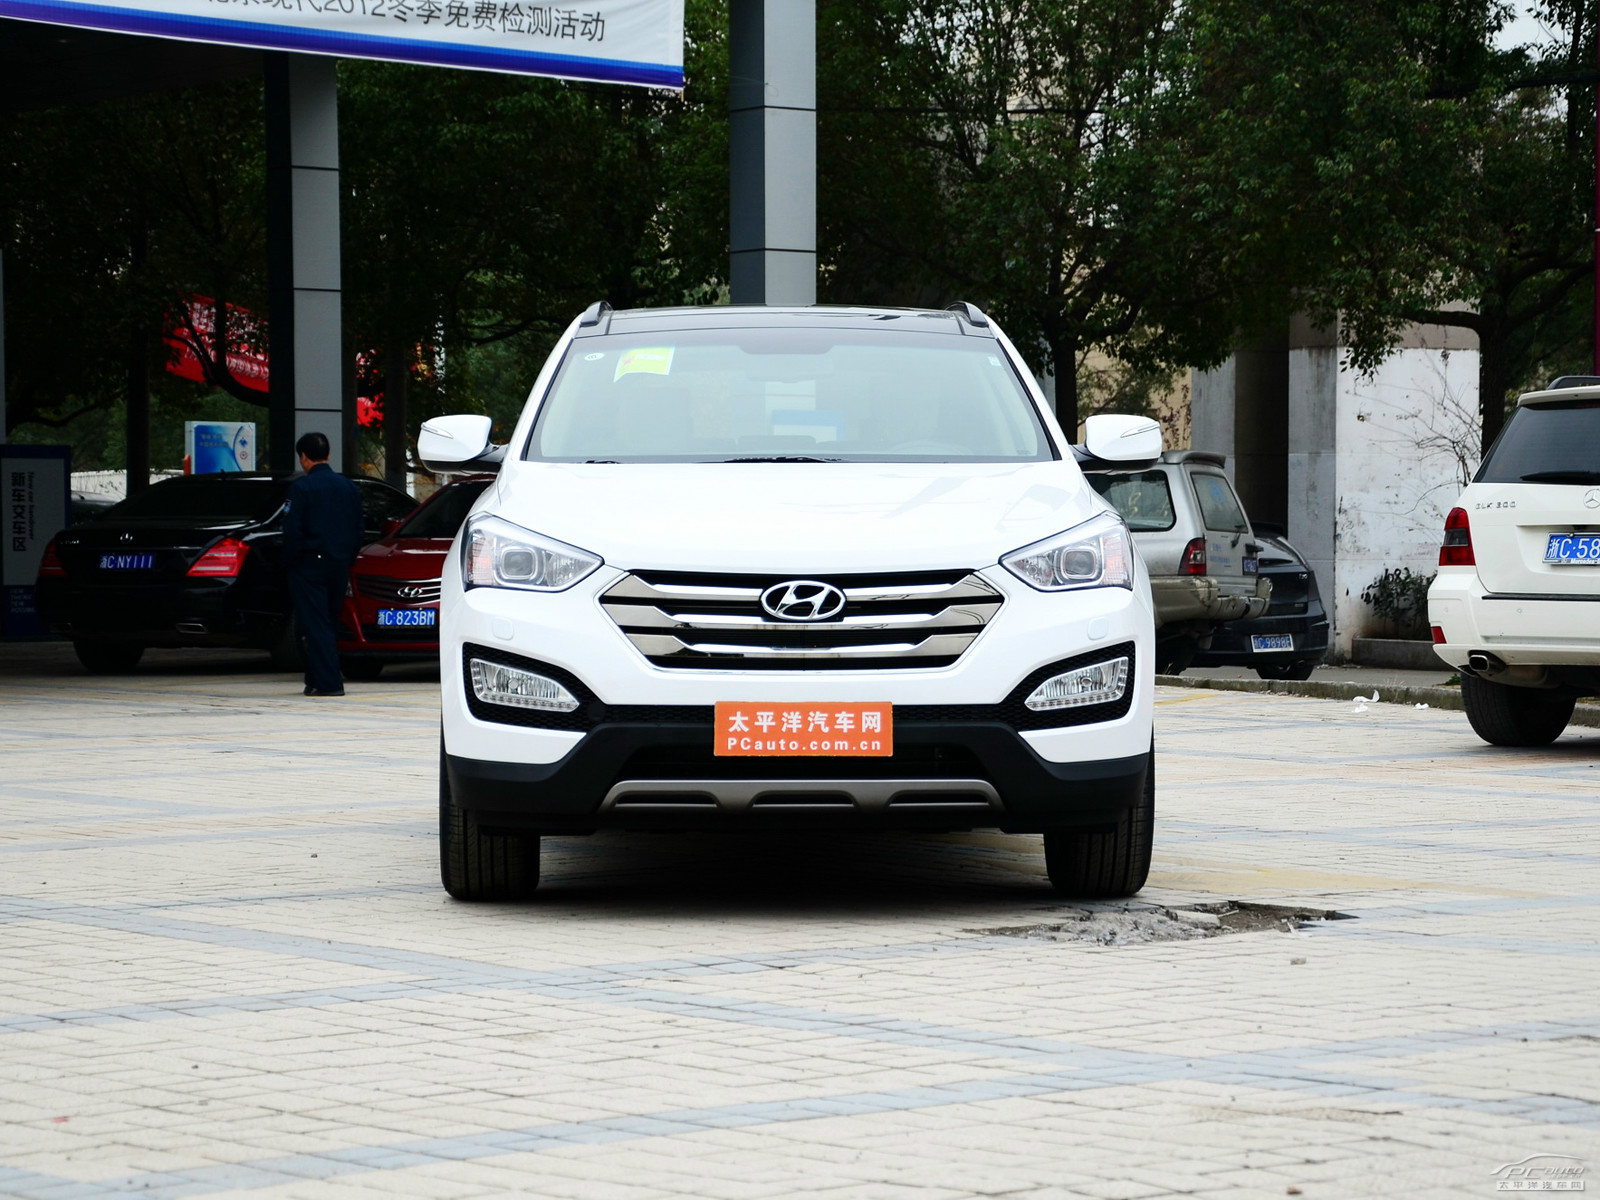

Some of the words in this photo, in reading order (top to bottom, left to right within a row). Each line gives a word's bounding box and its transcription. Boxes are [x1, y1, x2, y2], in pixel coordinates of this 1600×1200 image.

[206, 0, 606, 42] 2012冬季免费检测活动
[11, 471, 26, 552] 新车交车区
[728, 711, 882, 733] 太平洋汽车网
[727, 737, 881, 750] PCauto.com.cn
